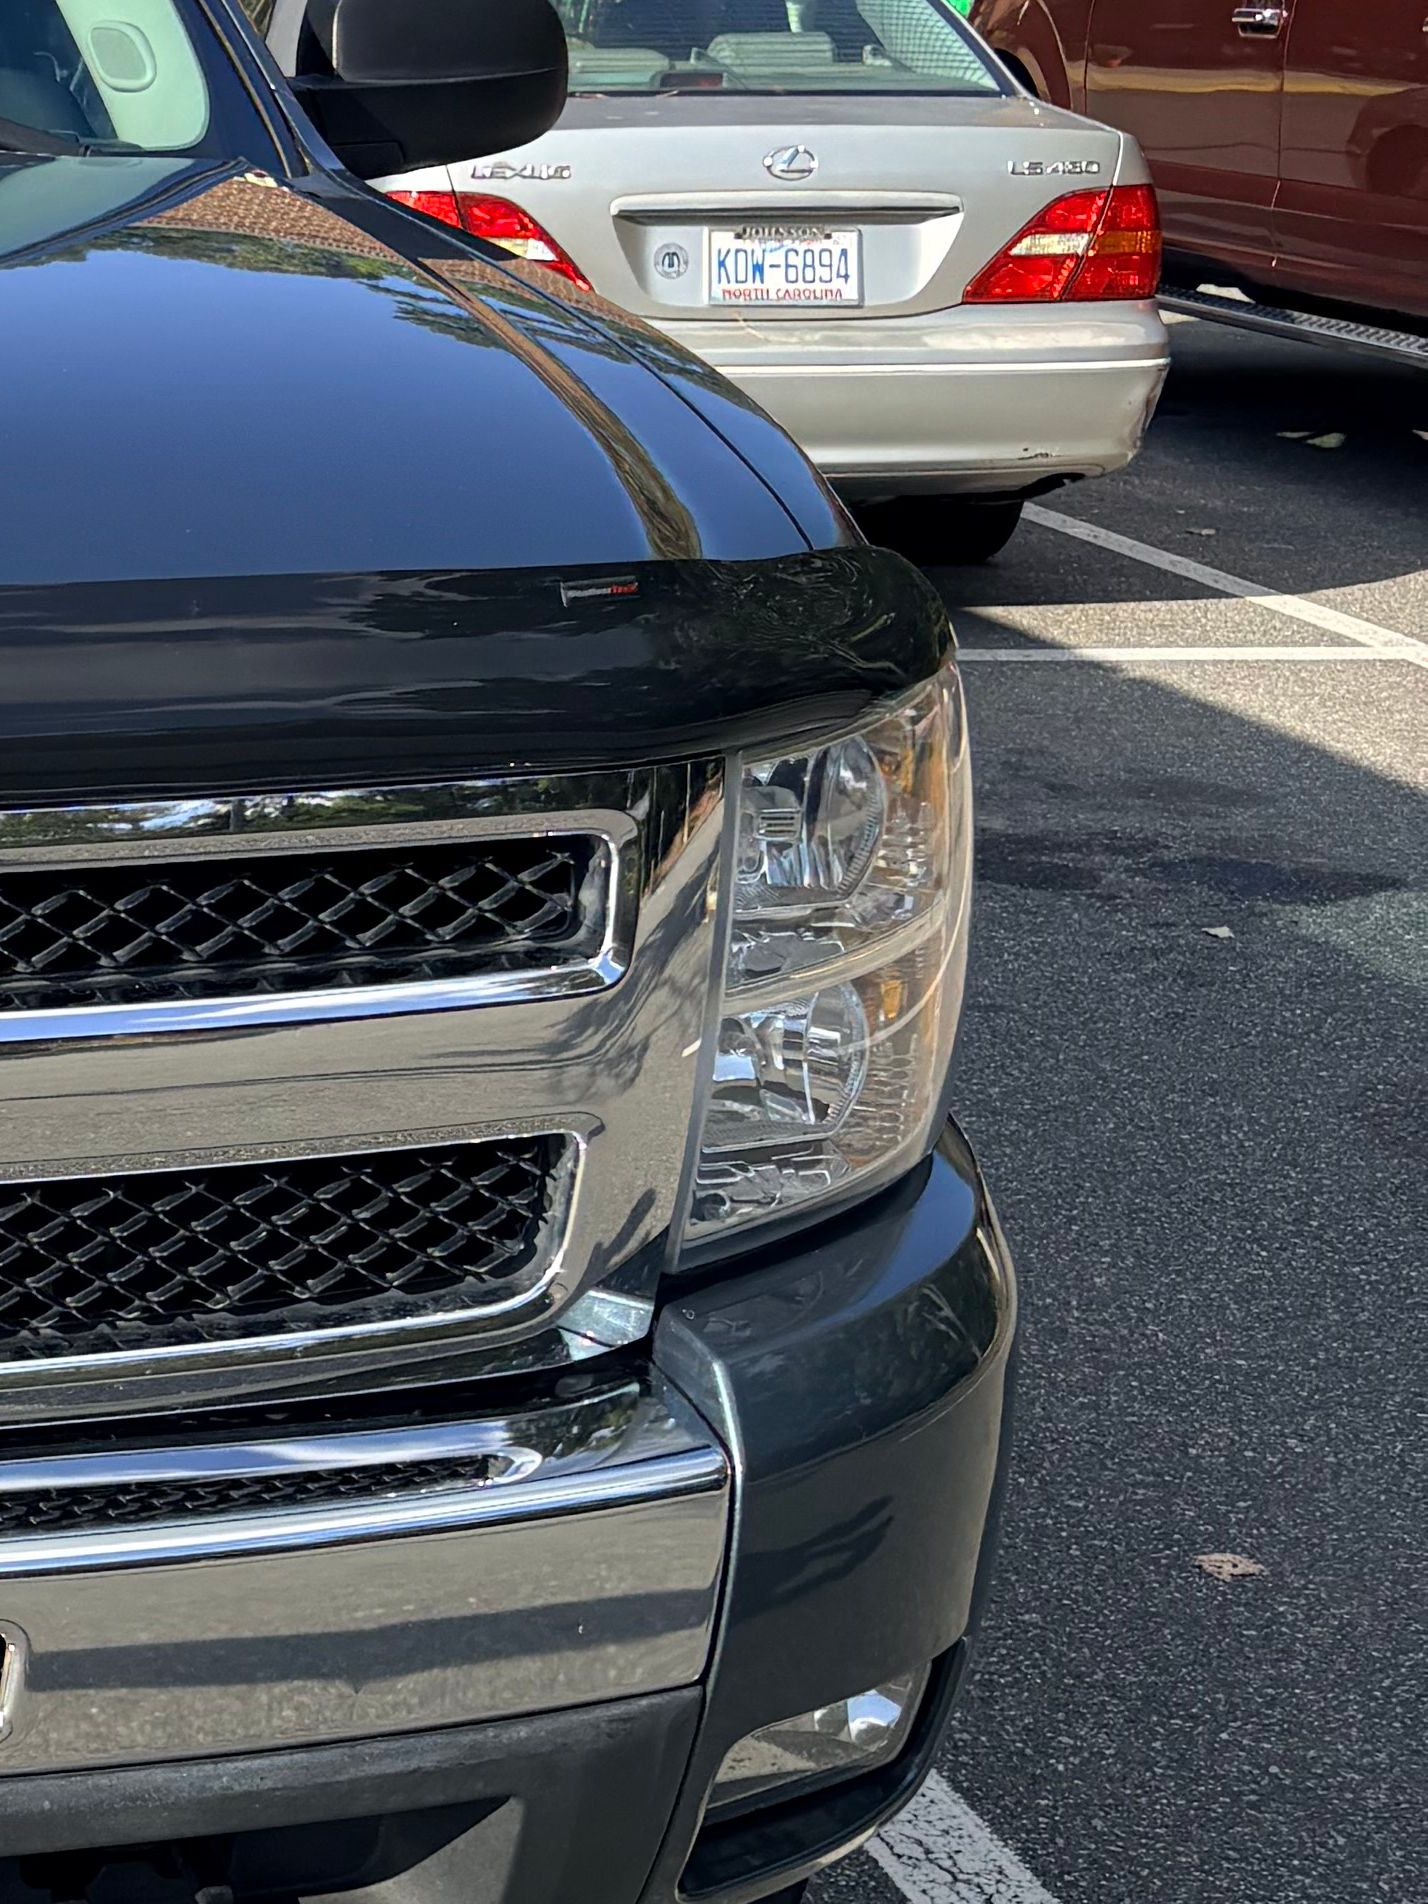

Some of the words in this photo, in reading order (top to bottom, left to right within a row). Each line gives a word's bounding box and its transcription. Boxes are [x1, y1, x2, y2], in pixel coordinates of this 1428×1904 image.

[471, 163, 572, 180] LEXUS
[716, 247, 851, 284] KDW-6894
[721, 288, 770, 301] NORTH
[775, 288, 843, 301] CAROLINA
